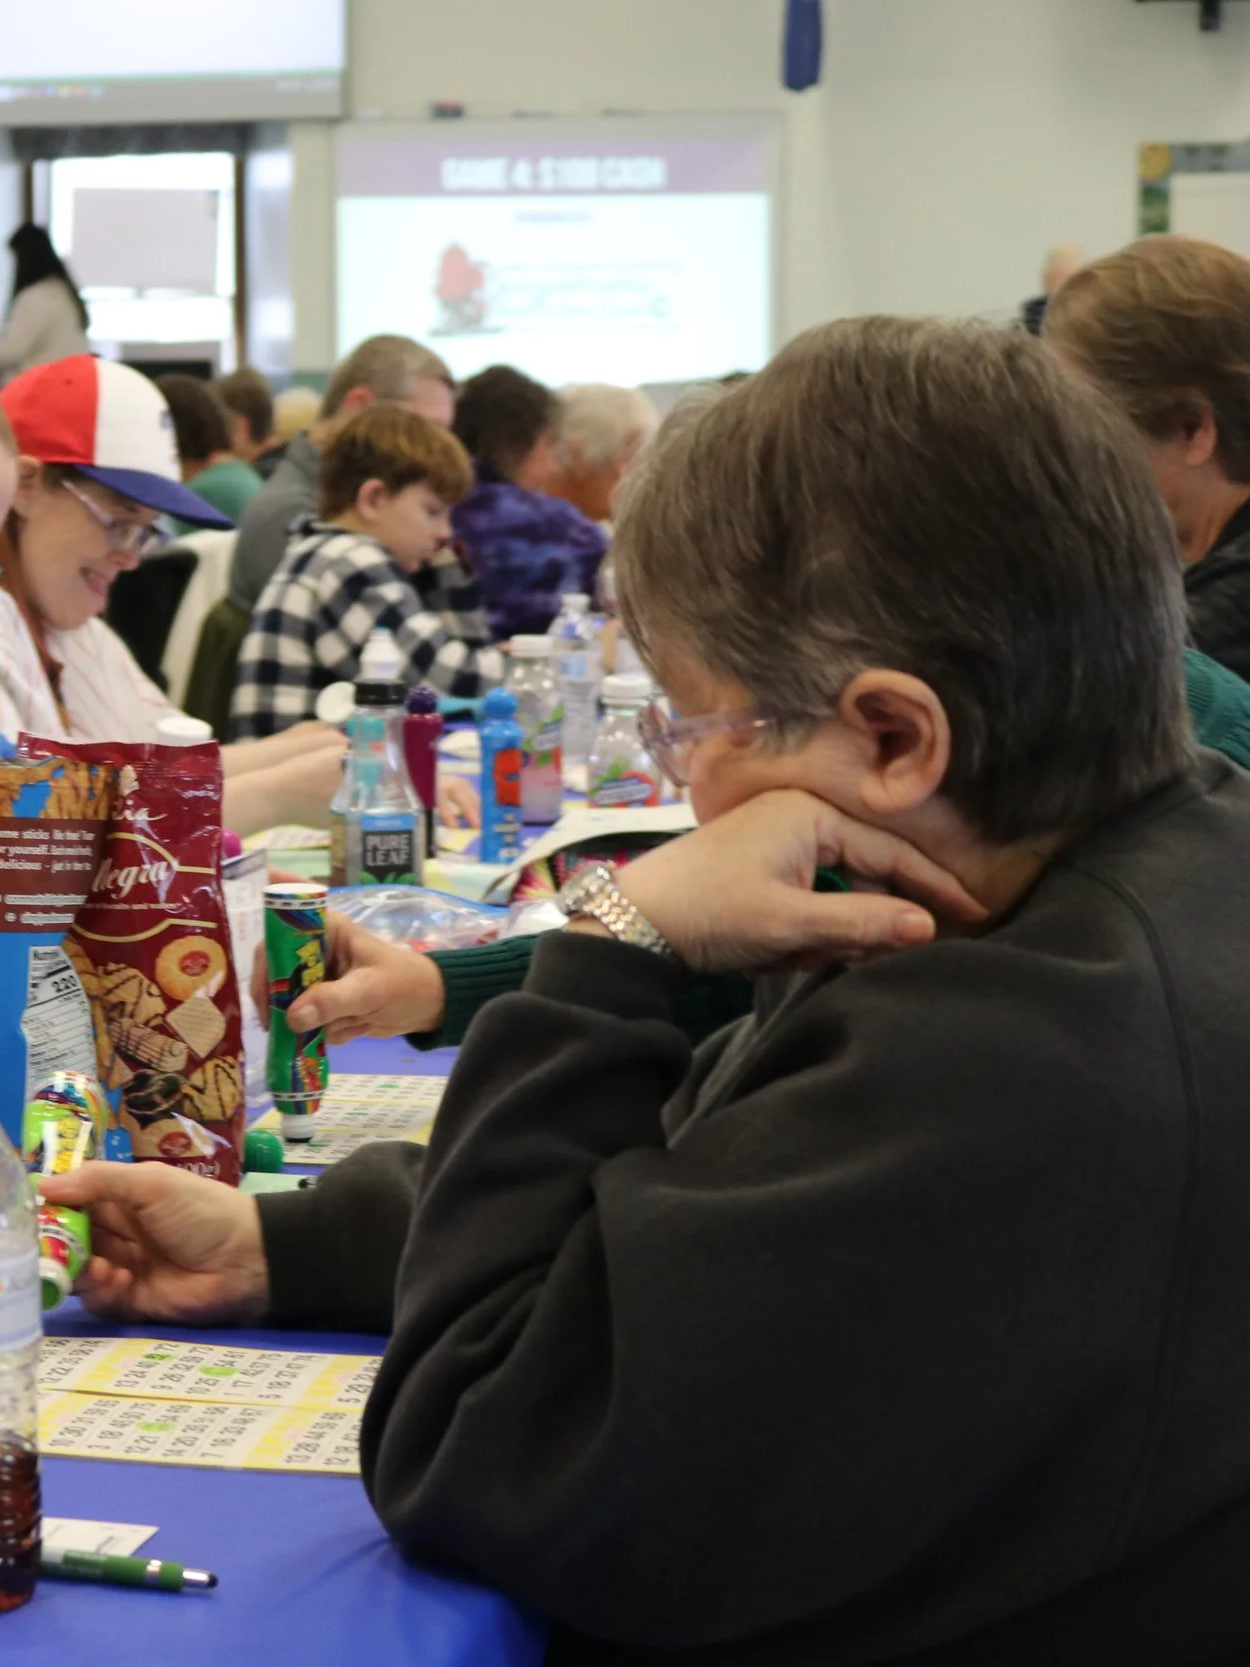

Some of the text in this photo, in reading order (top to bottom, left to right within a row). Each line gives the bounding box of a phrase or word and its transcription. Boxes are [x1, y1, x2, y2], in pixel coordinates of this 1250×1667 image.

[22, 828, 50, 840] sticks
[7, 844, 49, 856] yourself.
[365, 835, 409, 850] PURE
[366, 850, 409, 866] LEAF
[51, 975, 77, 993] 220
